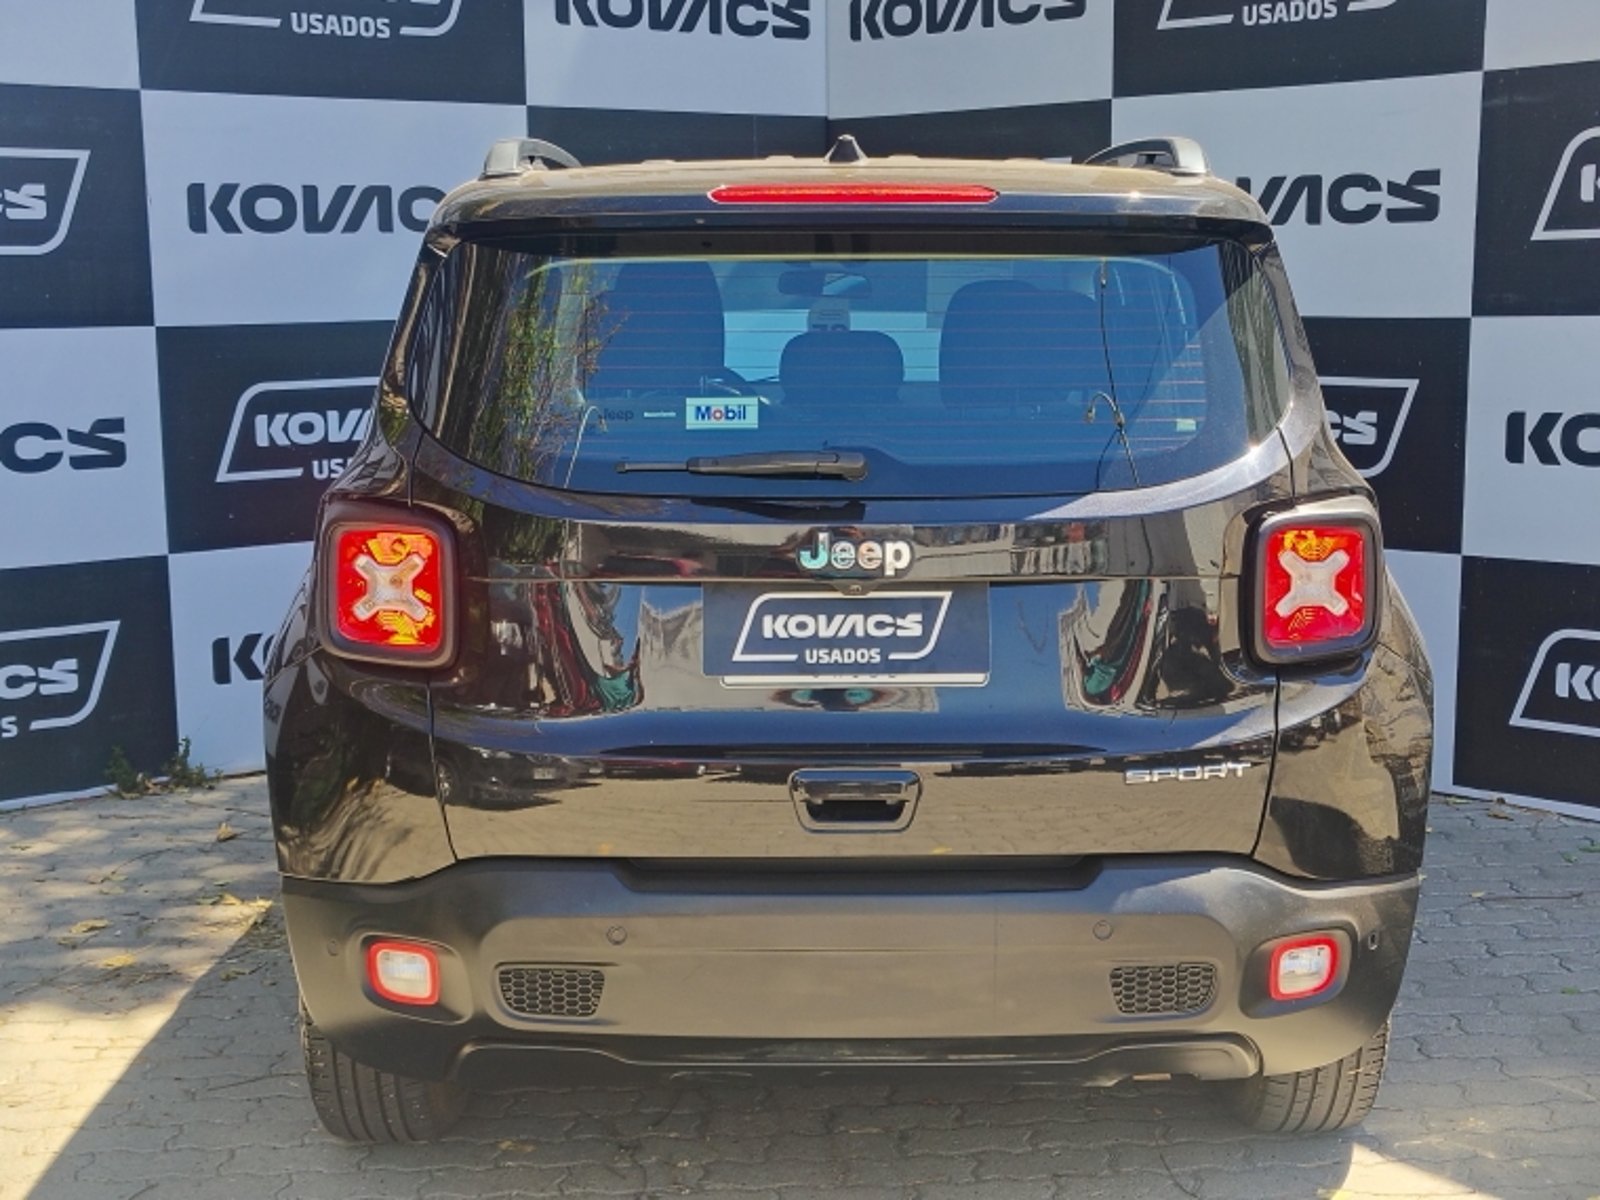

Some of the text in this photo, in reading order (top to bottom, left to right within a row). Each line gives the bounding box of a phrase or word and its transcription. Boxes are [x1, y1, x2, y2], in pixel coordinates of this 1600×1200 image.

[291, 12, 390, 38] USADOS
[1242, 0, 1337, 26] USADOS
[0, 183, 47, 219] S
[695, 404, 746, 421] Mobil
[799, 531, 911, 576] Jeep
[762, 612, 923, 639] KOVACS
[212, 633, 275, 685] K
[805, 648, 881, 665] USADOS
[1555, 662, 1600, 701] K
[1125, 761, 1251, 784] SPORT
